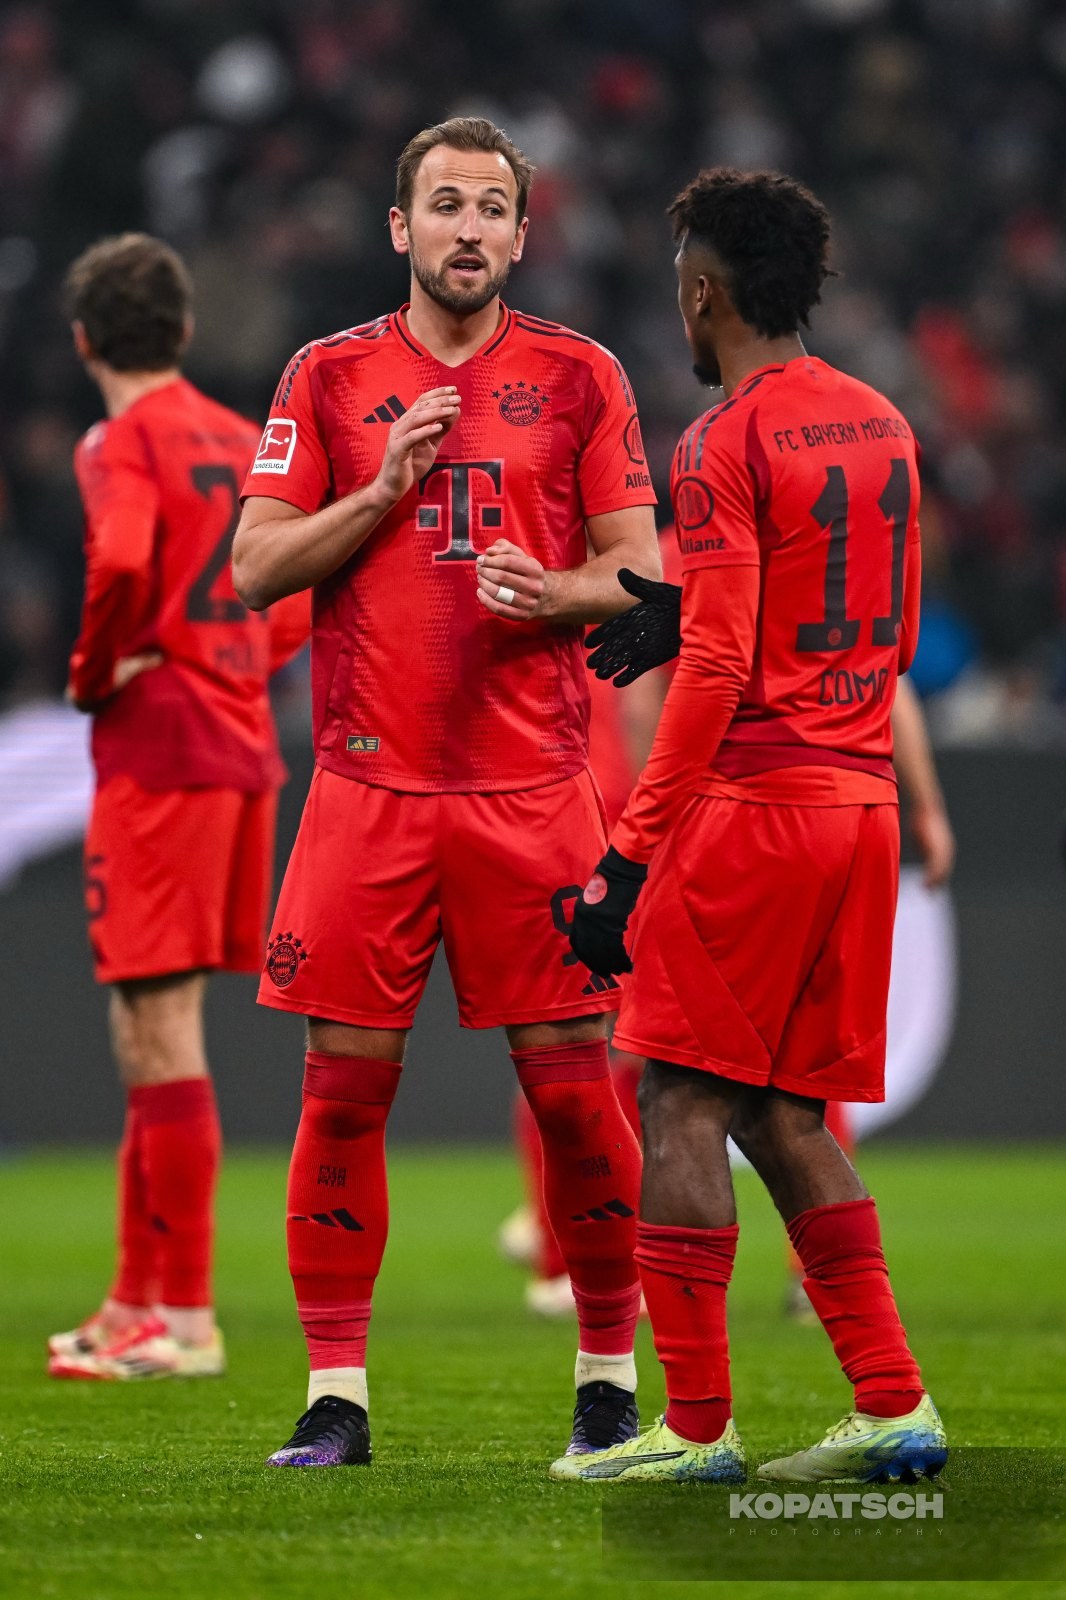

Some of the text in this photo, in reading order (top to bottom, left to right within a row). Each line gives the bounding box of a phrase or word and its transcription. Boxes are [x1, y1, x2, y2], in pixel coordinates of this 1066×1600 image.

[773, 429, 799, 453] FC
[801, 422, 860, 447] BAYERN
[187, 464, 268, 622] 2
[415, 458, 504, 565] T
[795, 458, 911, 652] 11
